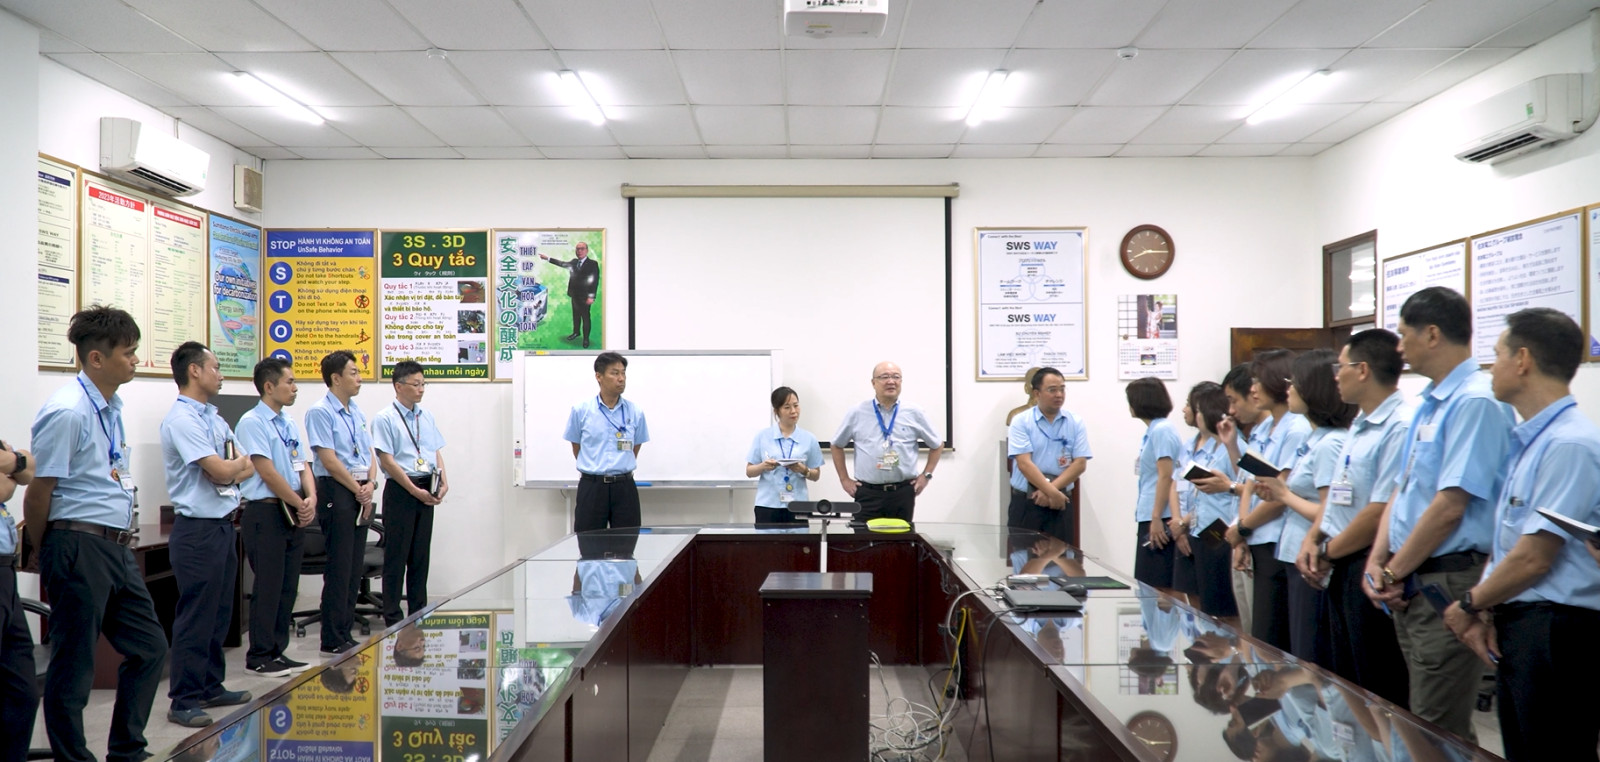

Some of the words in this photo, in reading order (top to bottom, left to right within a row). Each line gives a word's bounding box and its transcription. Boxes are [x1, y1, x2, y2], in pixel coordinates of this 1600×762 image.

[270, 241, 296, 250] STOP
[403, 235, 426, 248] 3S
[442, 235, 466, 248] 3D
[1006, 241, 1031, 250] SWS
[1033, 241, 1058, 250] WAY
[393, 253, 402, 266] 3
[408, 253, 444, 269] Quy
[449, 250, 476, 266] tắc
[276, 267, 287, 280] S
[276, 295, 286, 309] T
[500, 237, 518, 361] 安全文化の醸成
[1008, 314, 1030, 322] SWS
[1033, 314, 1056, 322] WAY
[274, 325, 288, 338] O
[447, 367, 462, 375] mỗi
